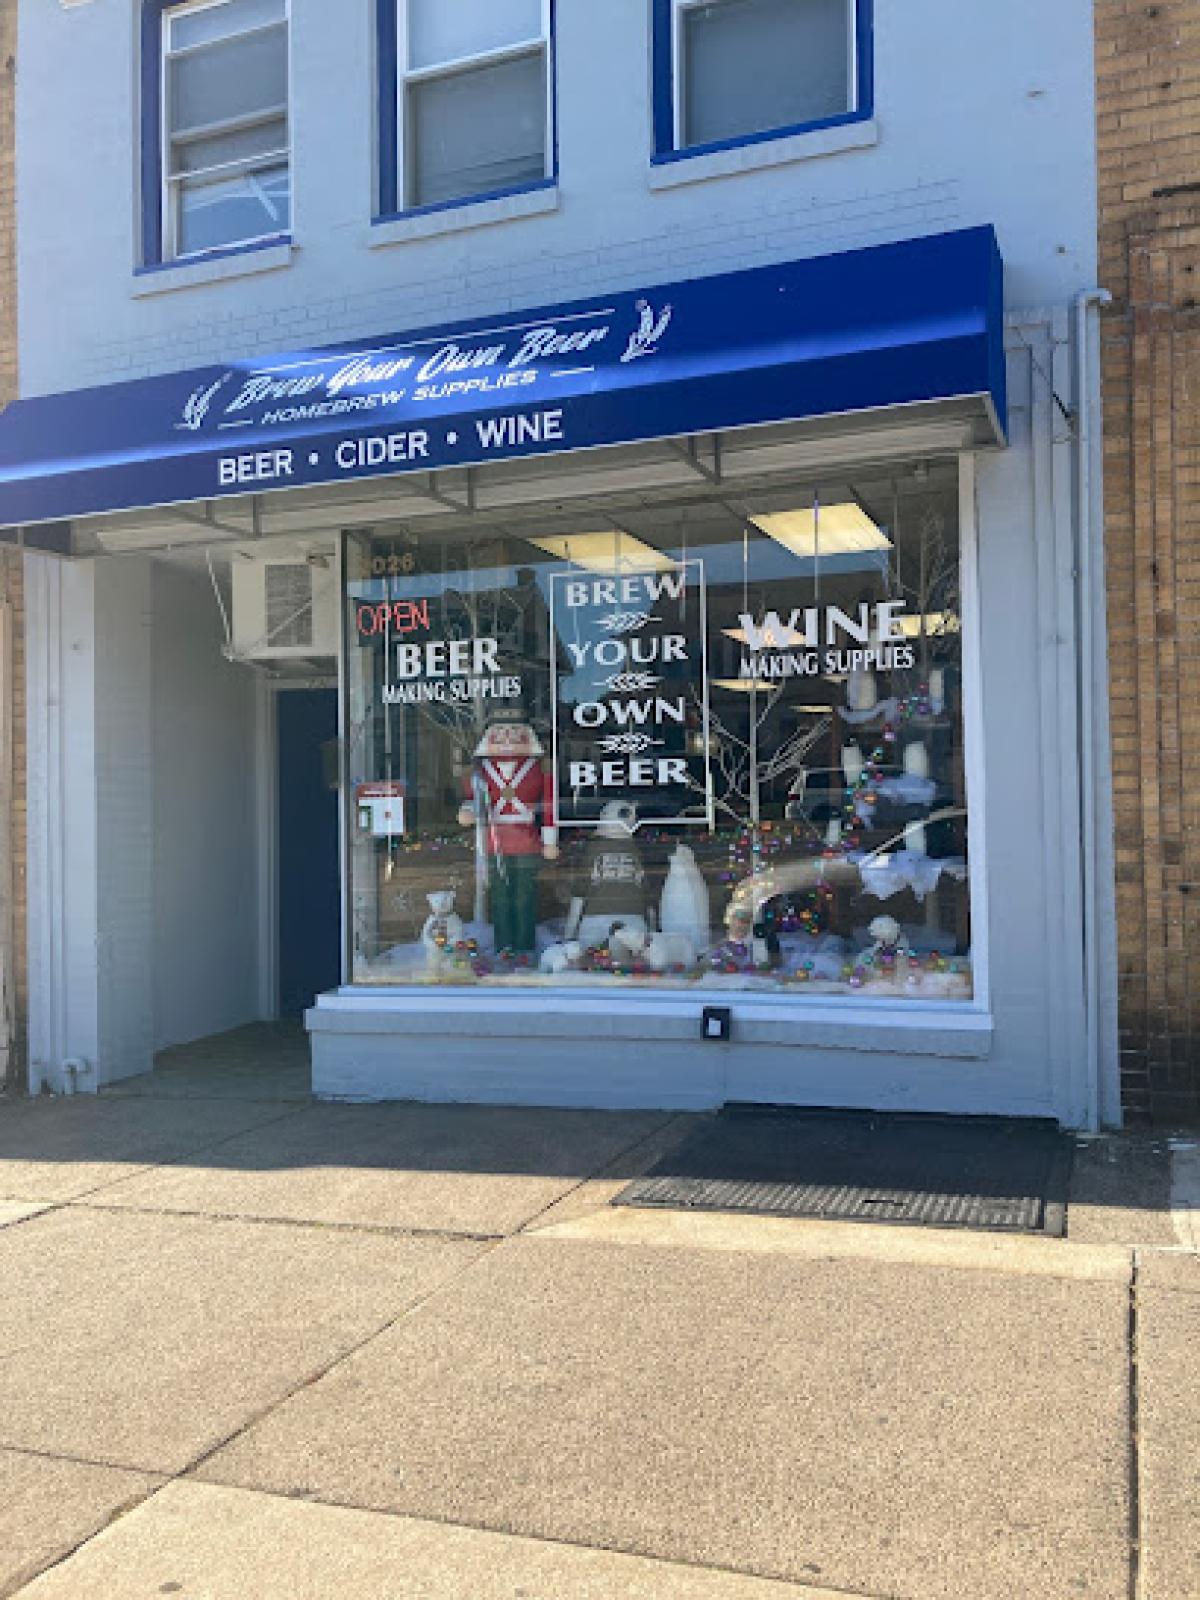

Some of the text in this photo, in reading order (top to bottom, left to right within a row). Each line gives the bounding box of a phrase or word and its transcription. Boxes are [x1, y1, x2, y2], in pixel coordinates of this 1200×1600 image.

[224, 325, 609, 413] Brew Your Own Beer
[412, 370, 538, 401] SUPPLIES
[218, 408, 564, 486] BEER CIDER WINE
[566, 572, 686, 607] BREW
[356, 599, 431, 636] OPEN
[737, 600, 907, 651] WINE
[396, 636, 501, 680] BEER
[567, 634, 689, 667] YOUR
[739, 646, 915, 678] MAKING SUPPLIES
[381, 675, 522, 704] MAKING SUPPLIES
[573, 696, 686, 728] OWN
[569, 758, 689, 787] BEER
